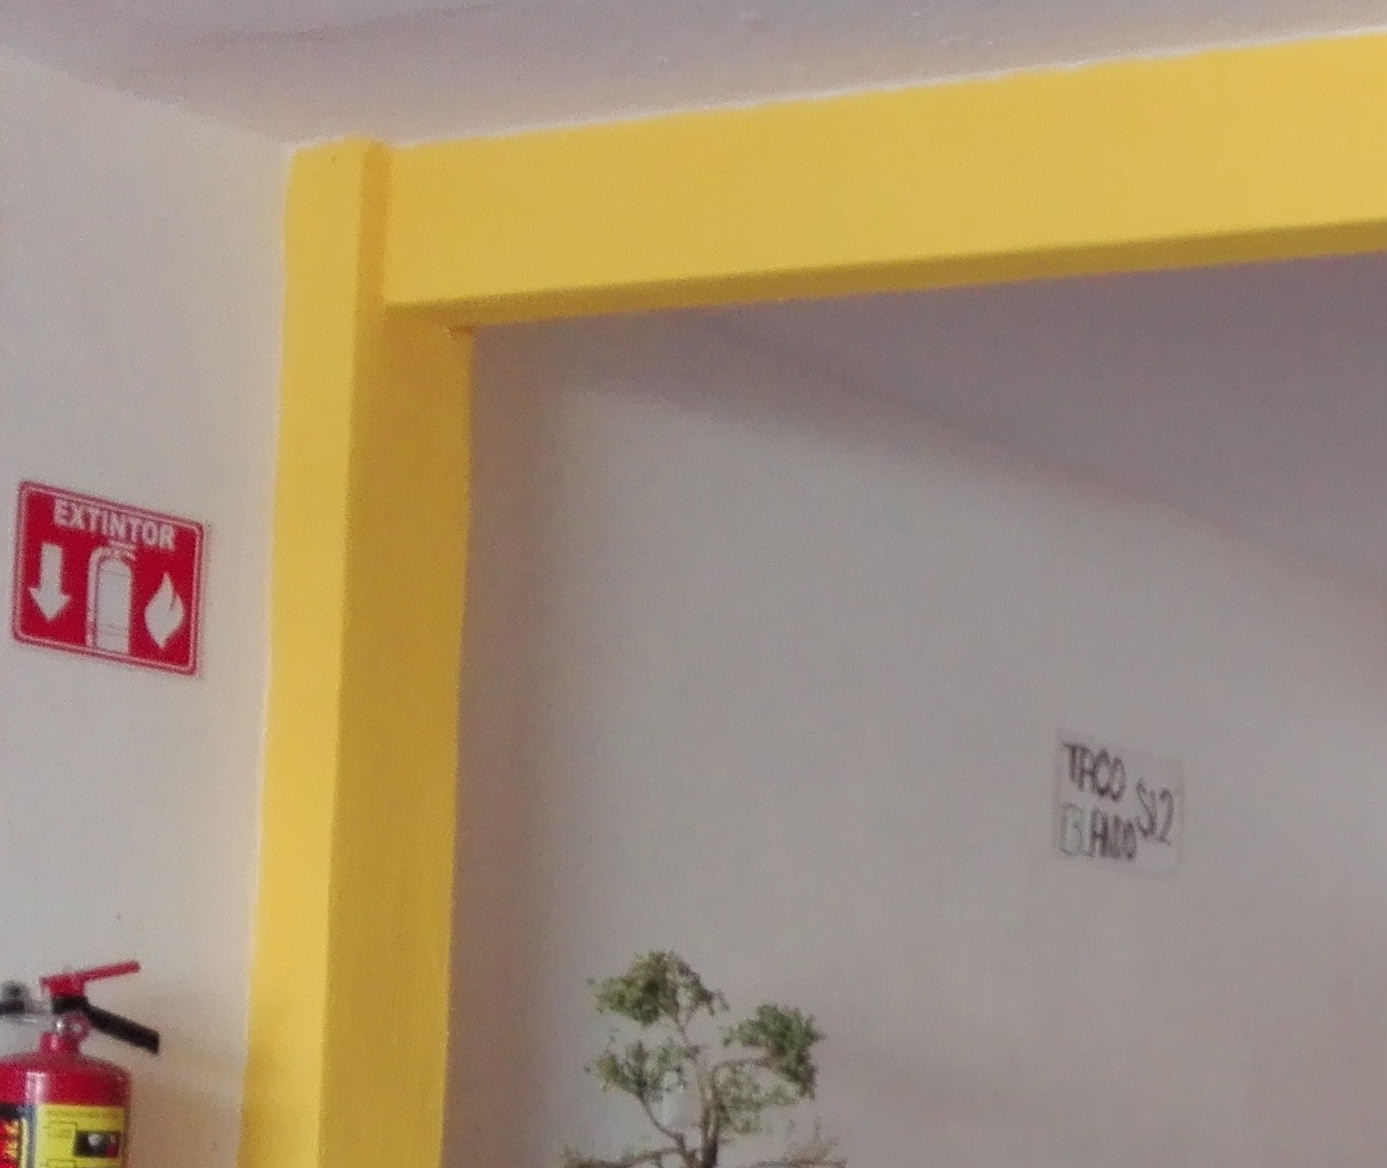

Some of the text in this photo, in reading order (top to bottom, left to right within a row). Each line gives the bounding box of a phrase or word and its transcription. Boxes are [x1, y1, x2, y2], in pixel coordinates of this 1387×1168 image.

[53, 499, 175, 550] EXTINTOR
[1062, 742, 1174, 846] TACO $2
